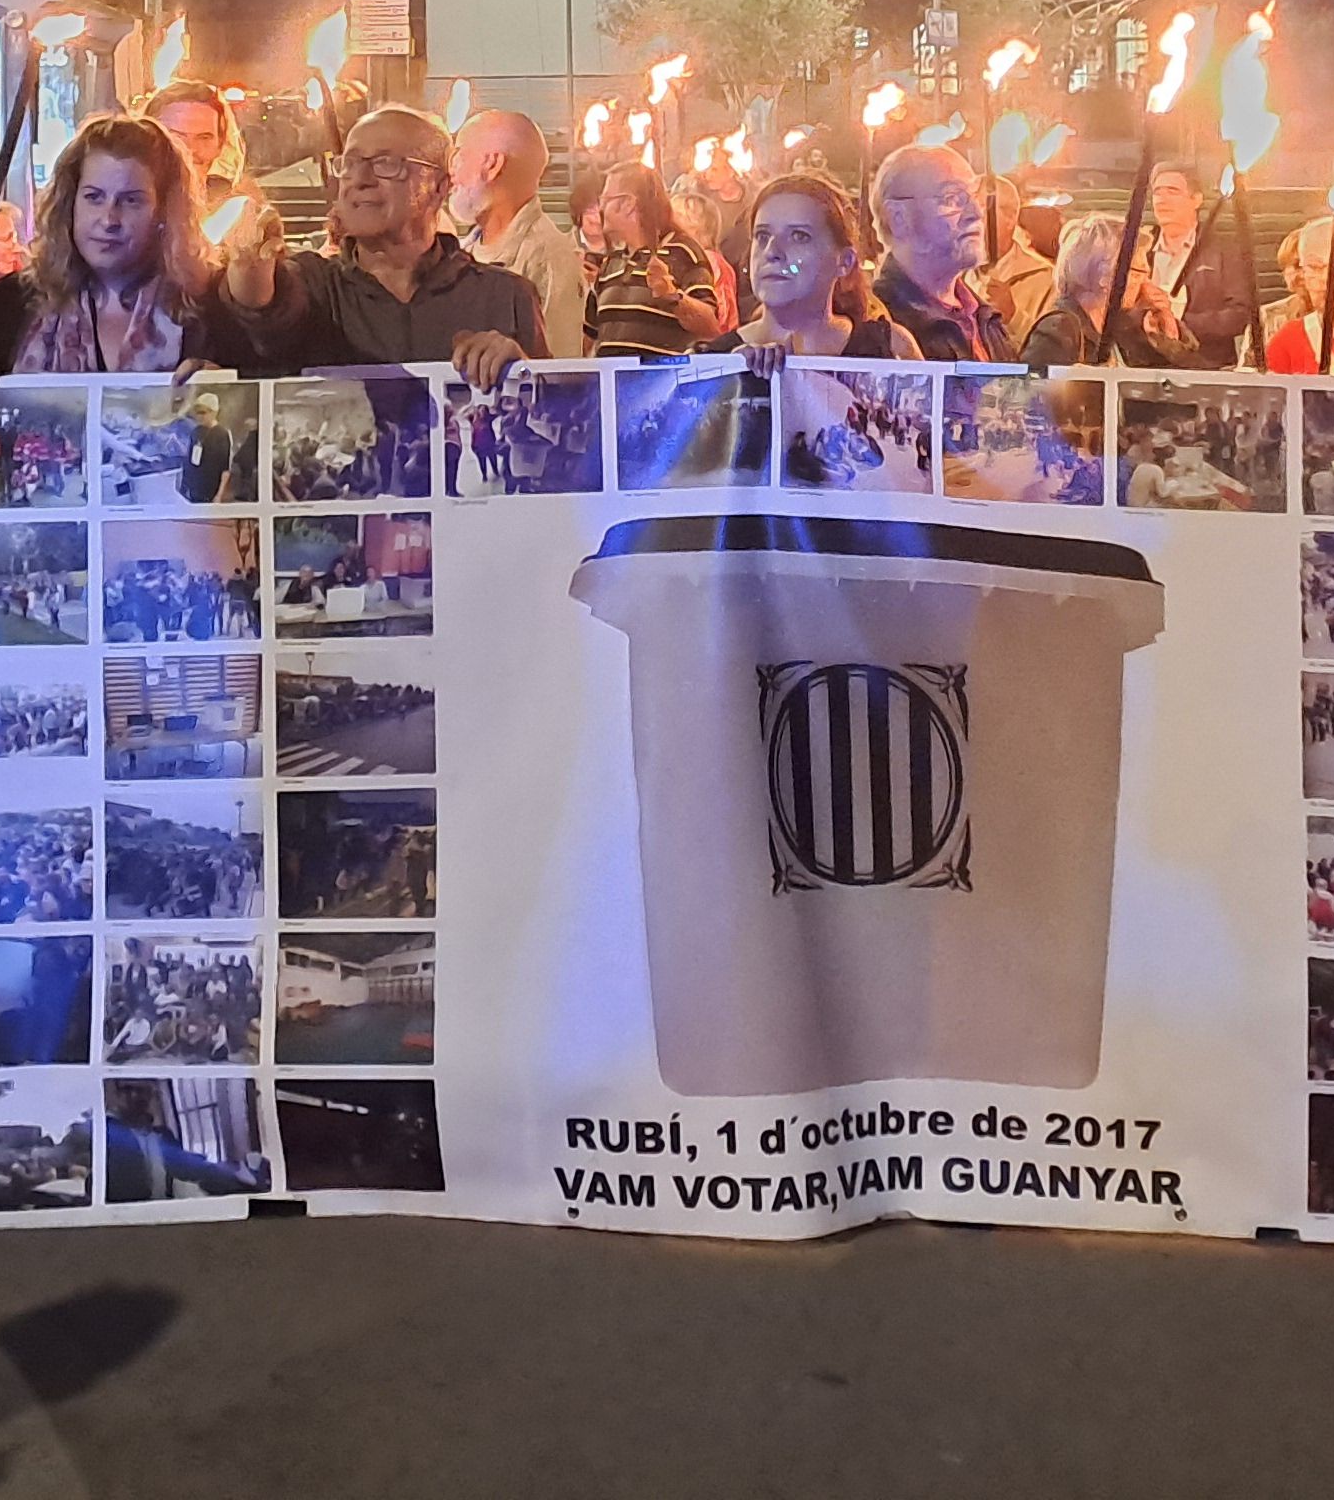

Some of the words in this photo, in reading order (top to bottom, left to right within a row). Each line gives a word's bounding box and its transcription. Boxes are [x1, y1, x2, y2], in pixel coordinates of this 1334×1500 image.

[565, 1111, 698, 1163] RUBÍ,
[716, 1120, 737, 1155] 1
[971, 1105, 1028, 1140] de
[1045, 1112, 1162, 1150] 2017
[553, 1166, 656, 1208] VAM
[942, 1157, 1184, 1206] GUANYAR
